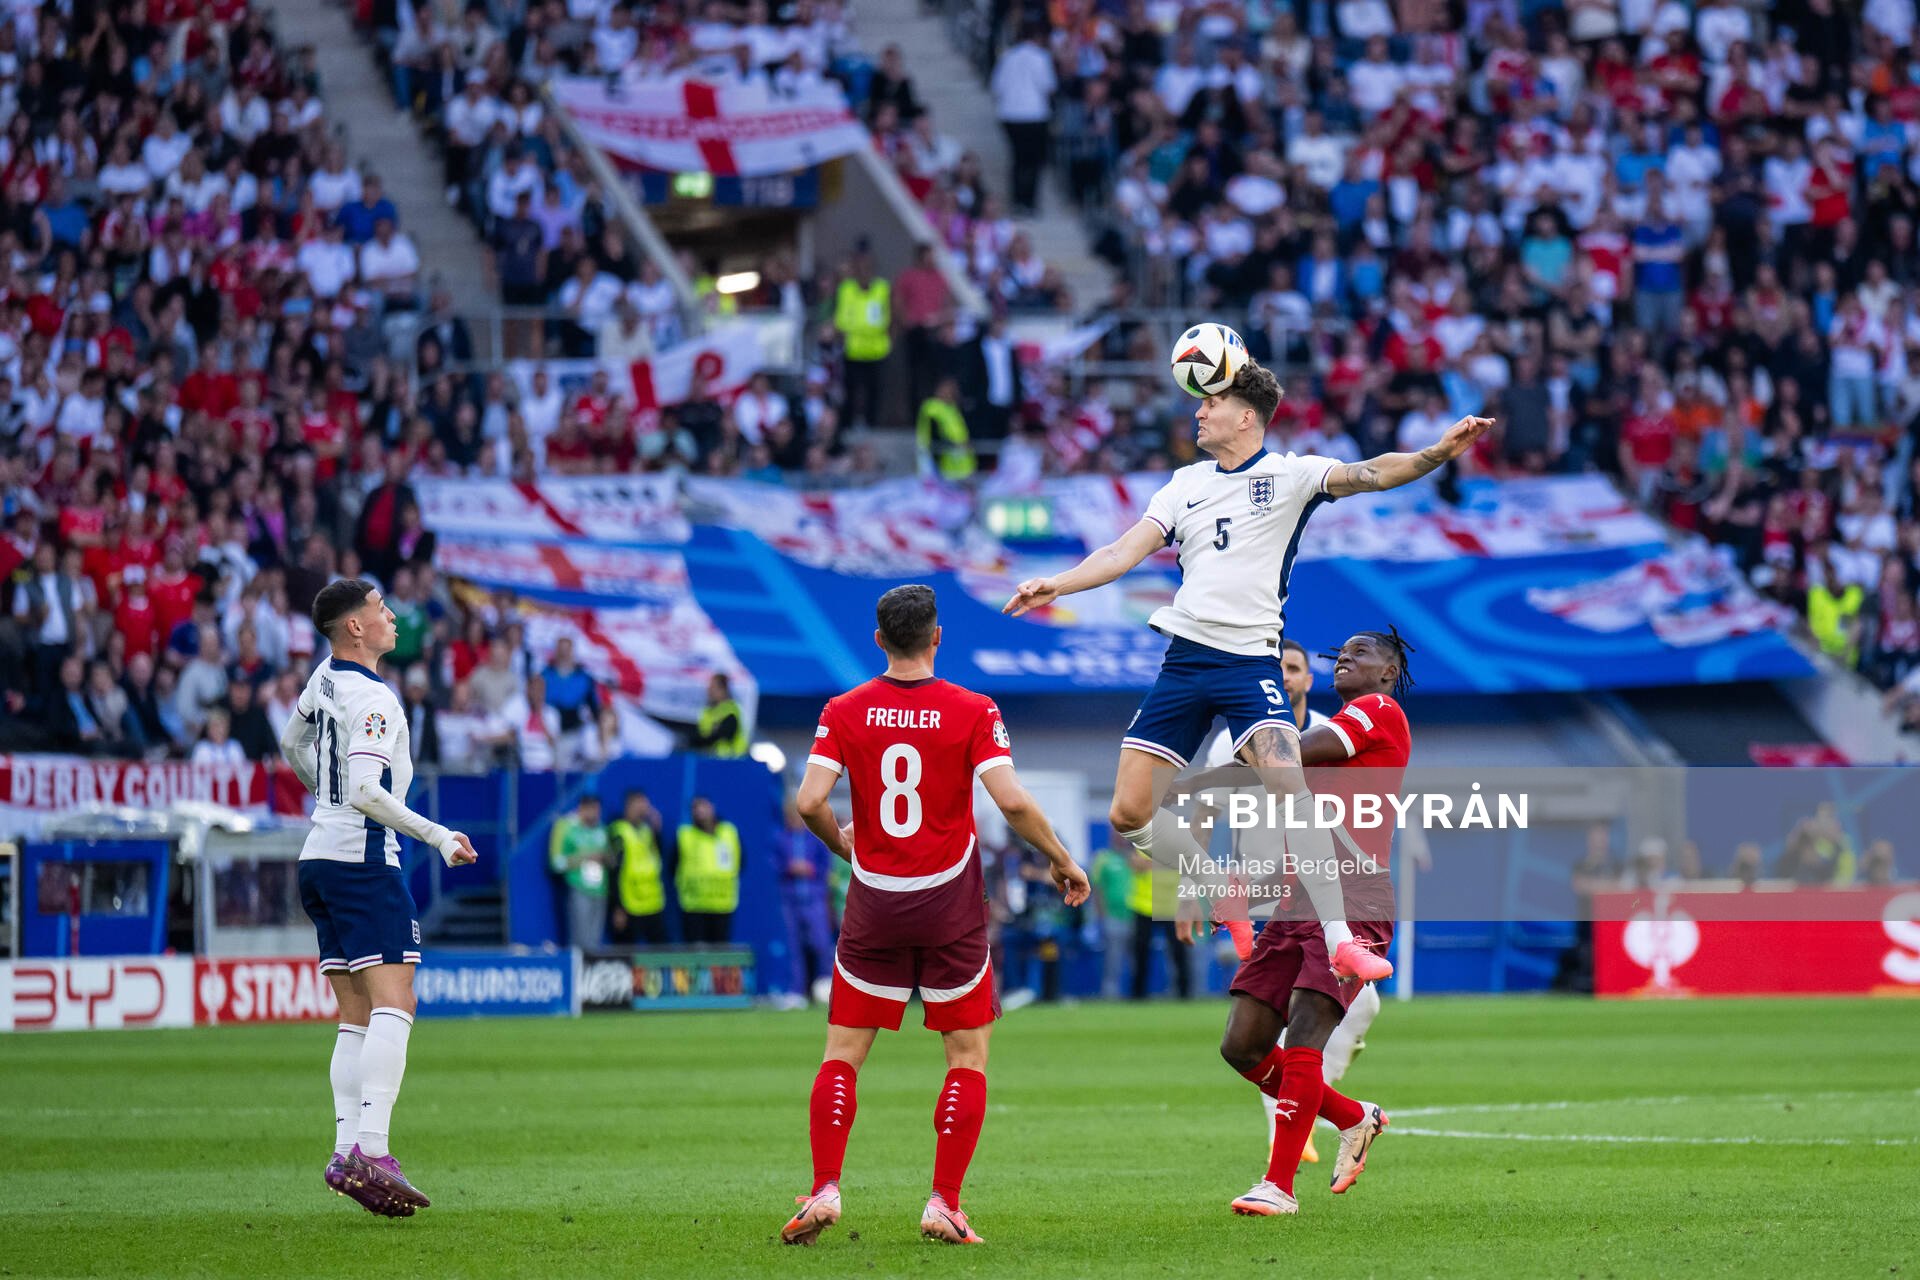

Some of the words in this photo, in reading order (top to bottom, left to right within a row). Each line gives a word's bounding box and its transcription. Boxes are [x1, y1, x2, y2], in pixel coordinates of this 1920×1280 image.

[1213, 517, 1232, 551] 5
[1259, 679, 1285, 706] 5
[866, 707, 941, 729] FREULER
[315, 708, 342, 806] 11
[11, 759, 119, 808] DERBY
[123, 762, 255, 809] COUNTY
[880, 743, 922, 838] 8
[14, 966, 164, 1025] BYD
